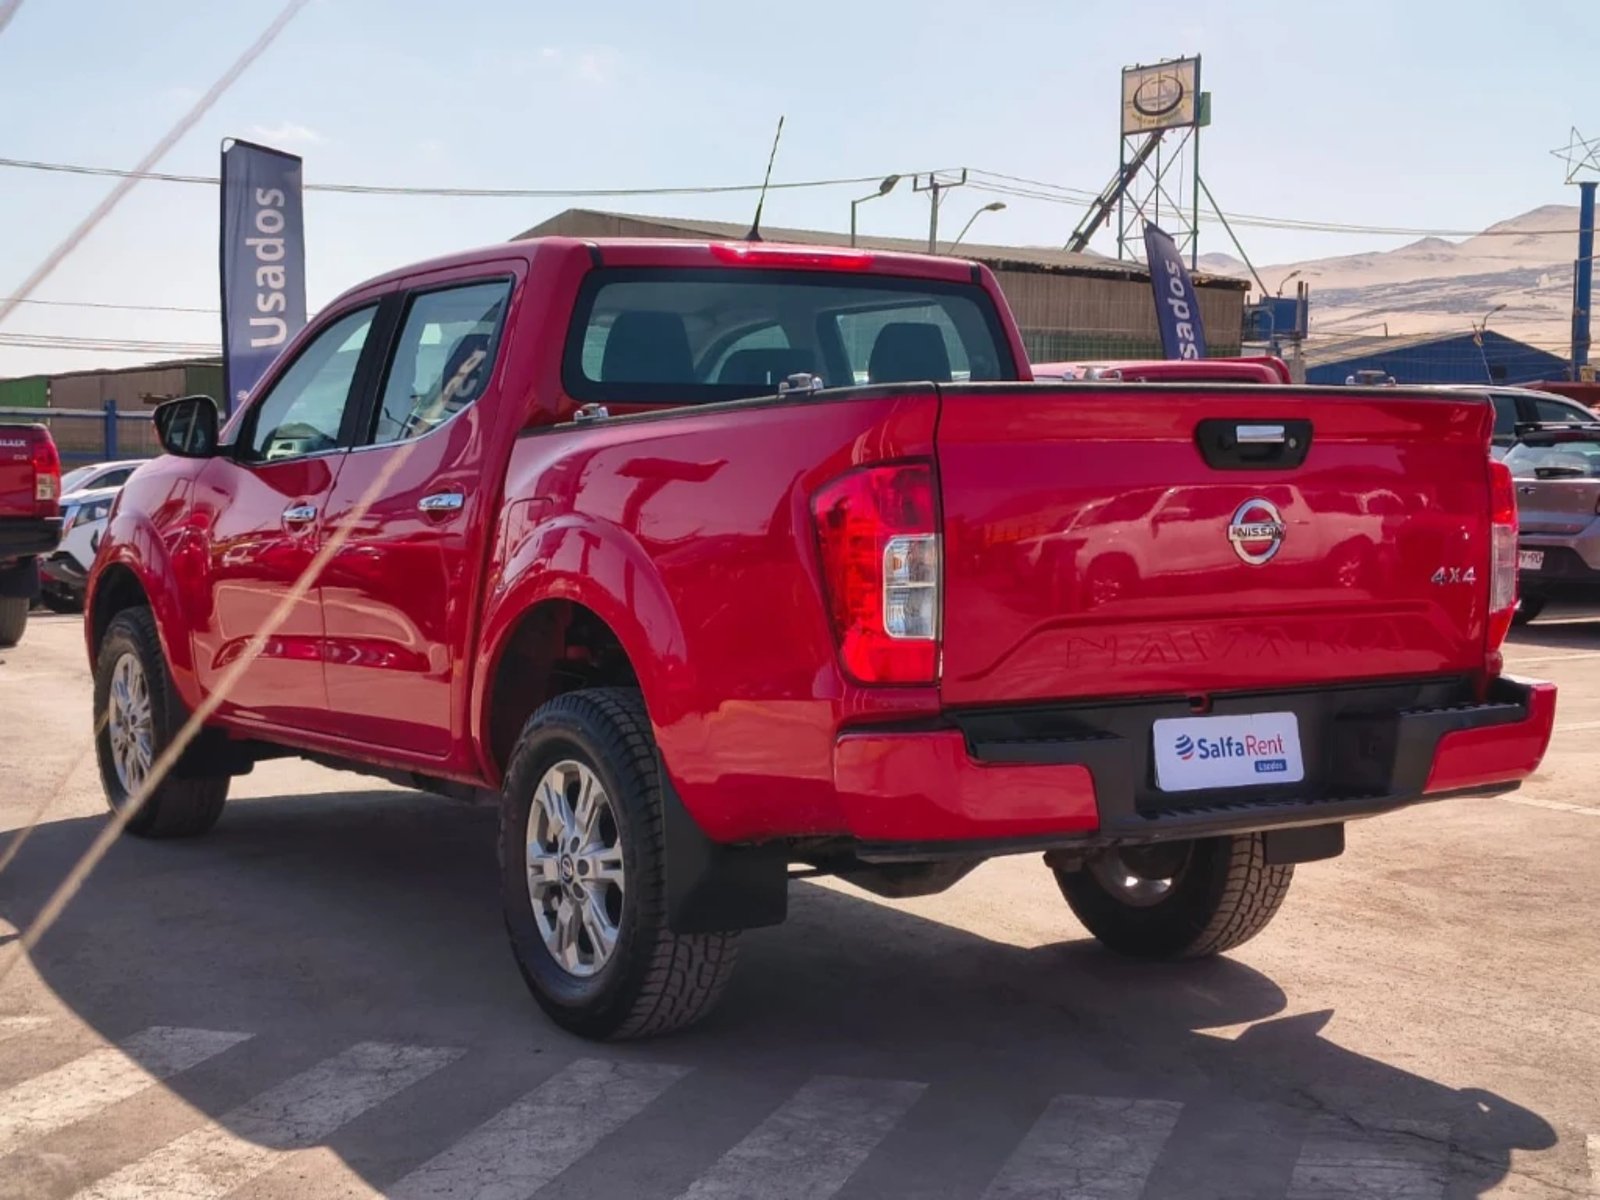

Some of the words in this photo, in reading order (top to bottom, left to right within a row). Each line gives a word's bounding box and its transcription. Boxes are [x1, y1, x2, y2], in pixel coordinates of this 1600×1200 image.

[245, 187, 287, 348] Usados
[1165, 259, 1199, 360] sados
[1197, 733, 1285, 760] SalfaRent
